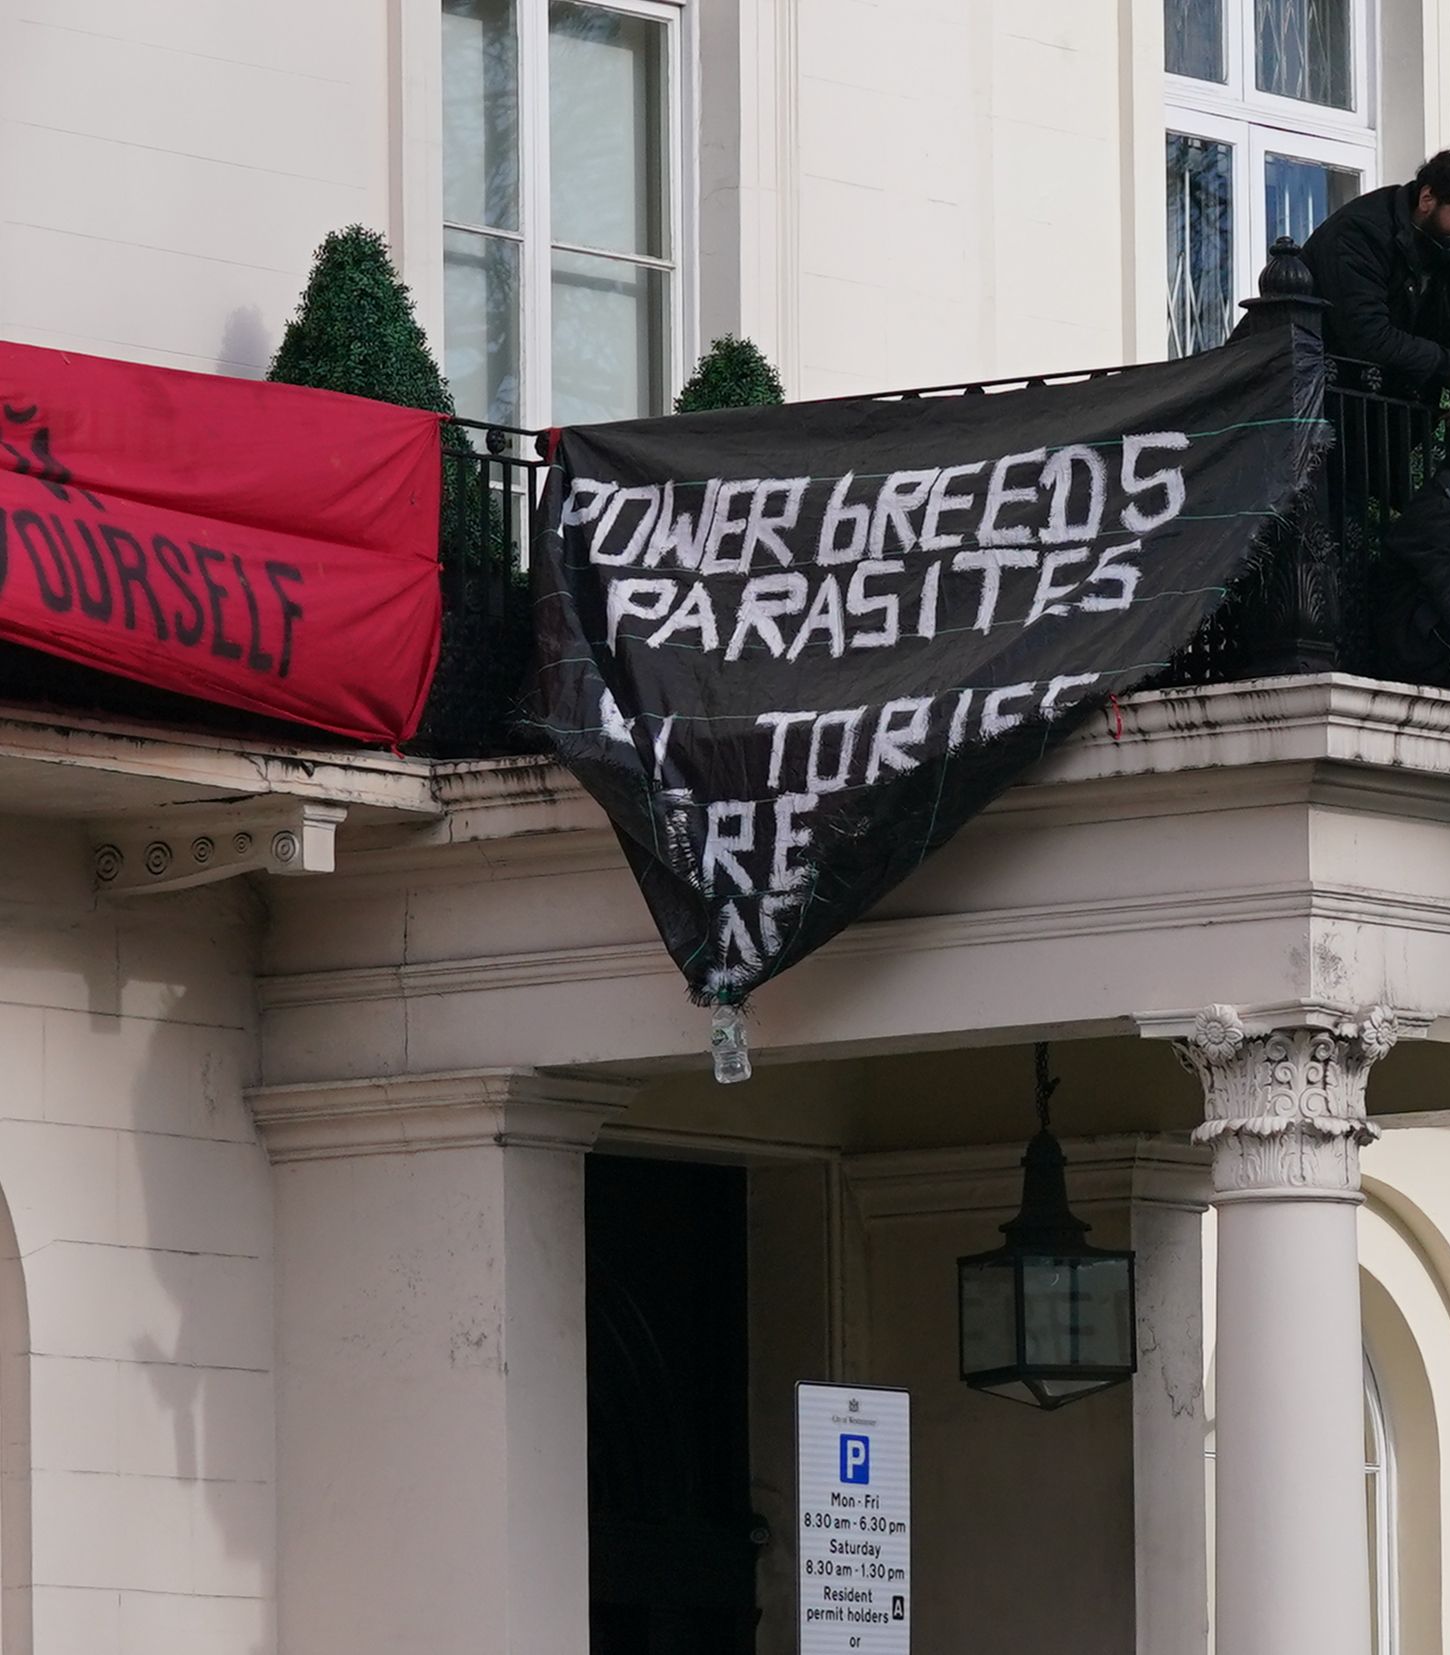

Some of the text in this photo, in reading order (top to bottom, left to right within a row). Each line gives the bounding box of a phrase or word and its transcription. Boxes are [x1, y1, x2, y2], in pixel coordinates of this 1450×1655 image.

[557, 476, 811, 576] POWER
[0, 506, 304, 679] OURSELF
[606, 538, 1144, 662] PARASITES
[847, 1439, 866, 1479] P
[831, 1492, 855, 1508] Mon
[864, 1494, 879, 1509] Fri
[804, 1512, 831, 1528] 8.30
[834, 1518, 851, 1529] am
[859, 1516, 887, 1532] 6.30
[889, 1521, 906, 1535] pm
[829, 1538, 881, 1560] Saturday
[806, 1559, 833, 1576] 8.30
[836, 1565, 853, 1577] am
[861, 1563, 886, 1579] 1.30
[888, 1568, 905, 1581] pm
[823, 1585, 873, 1603] Resident
[806, 1607, 843, 1622] permit
[847, 1607, 889, 1624] holders
[849, 1636, 861, 1648] or
